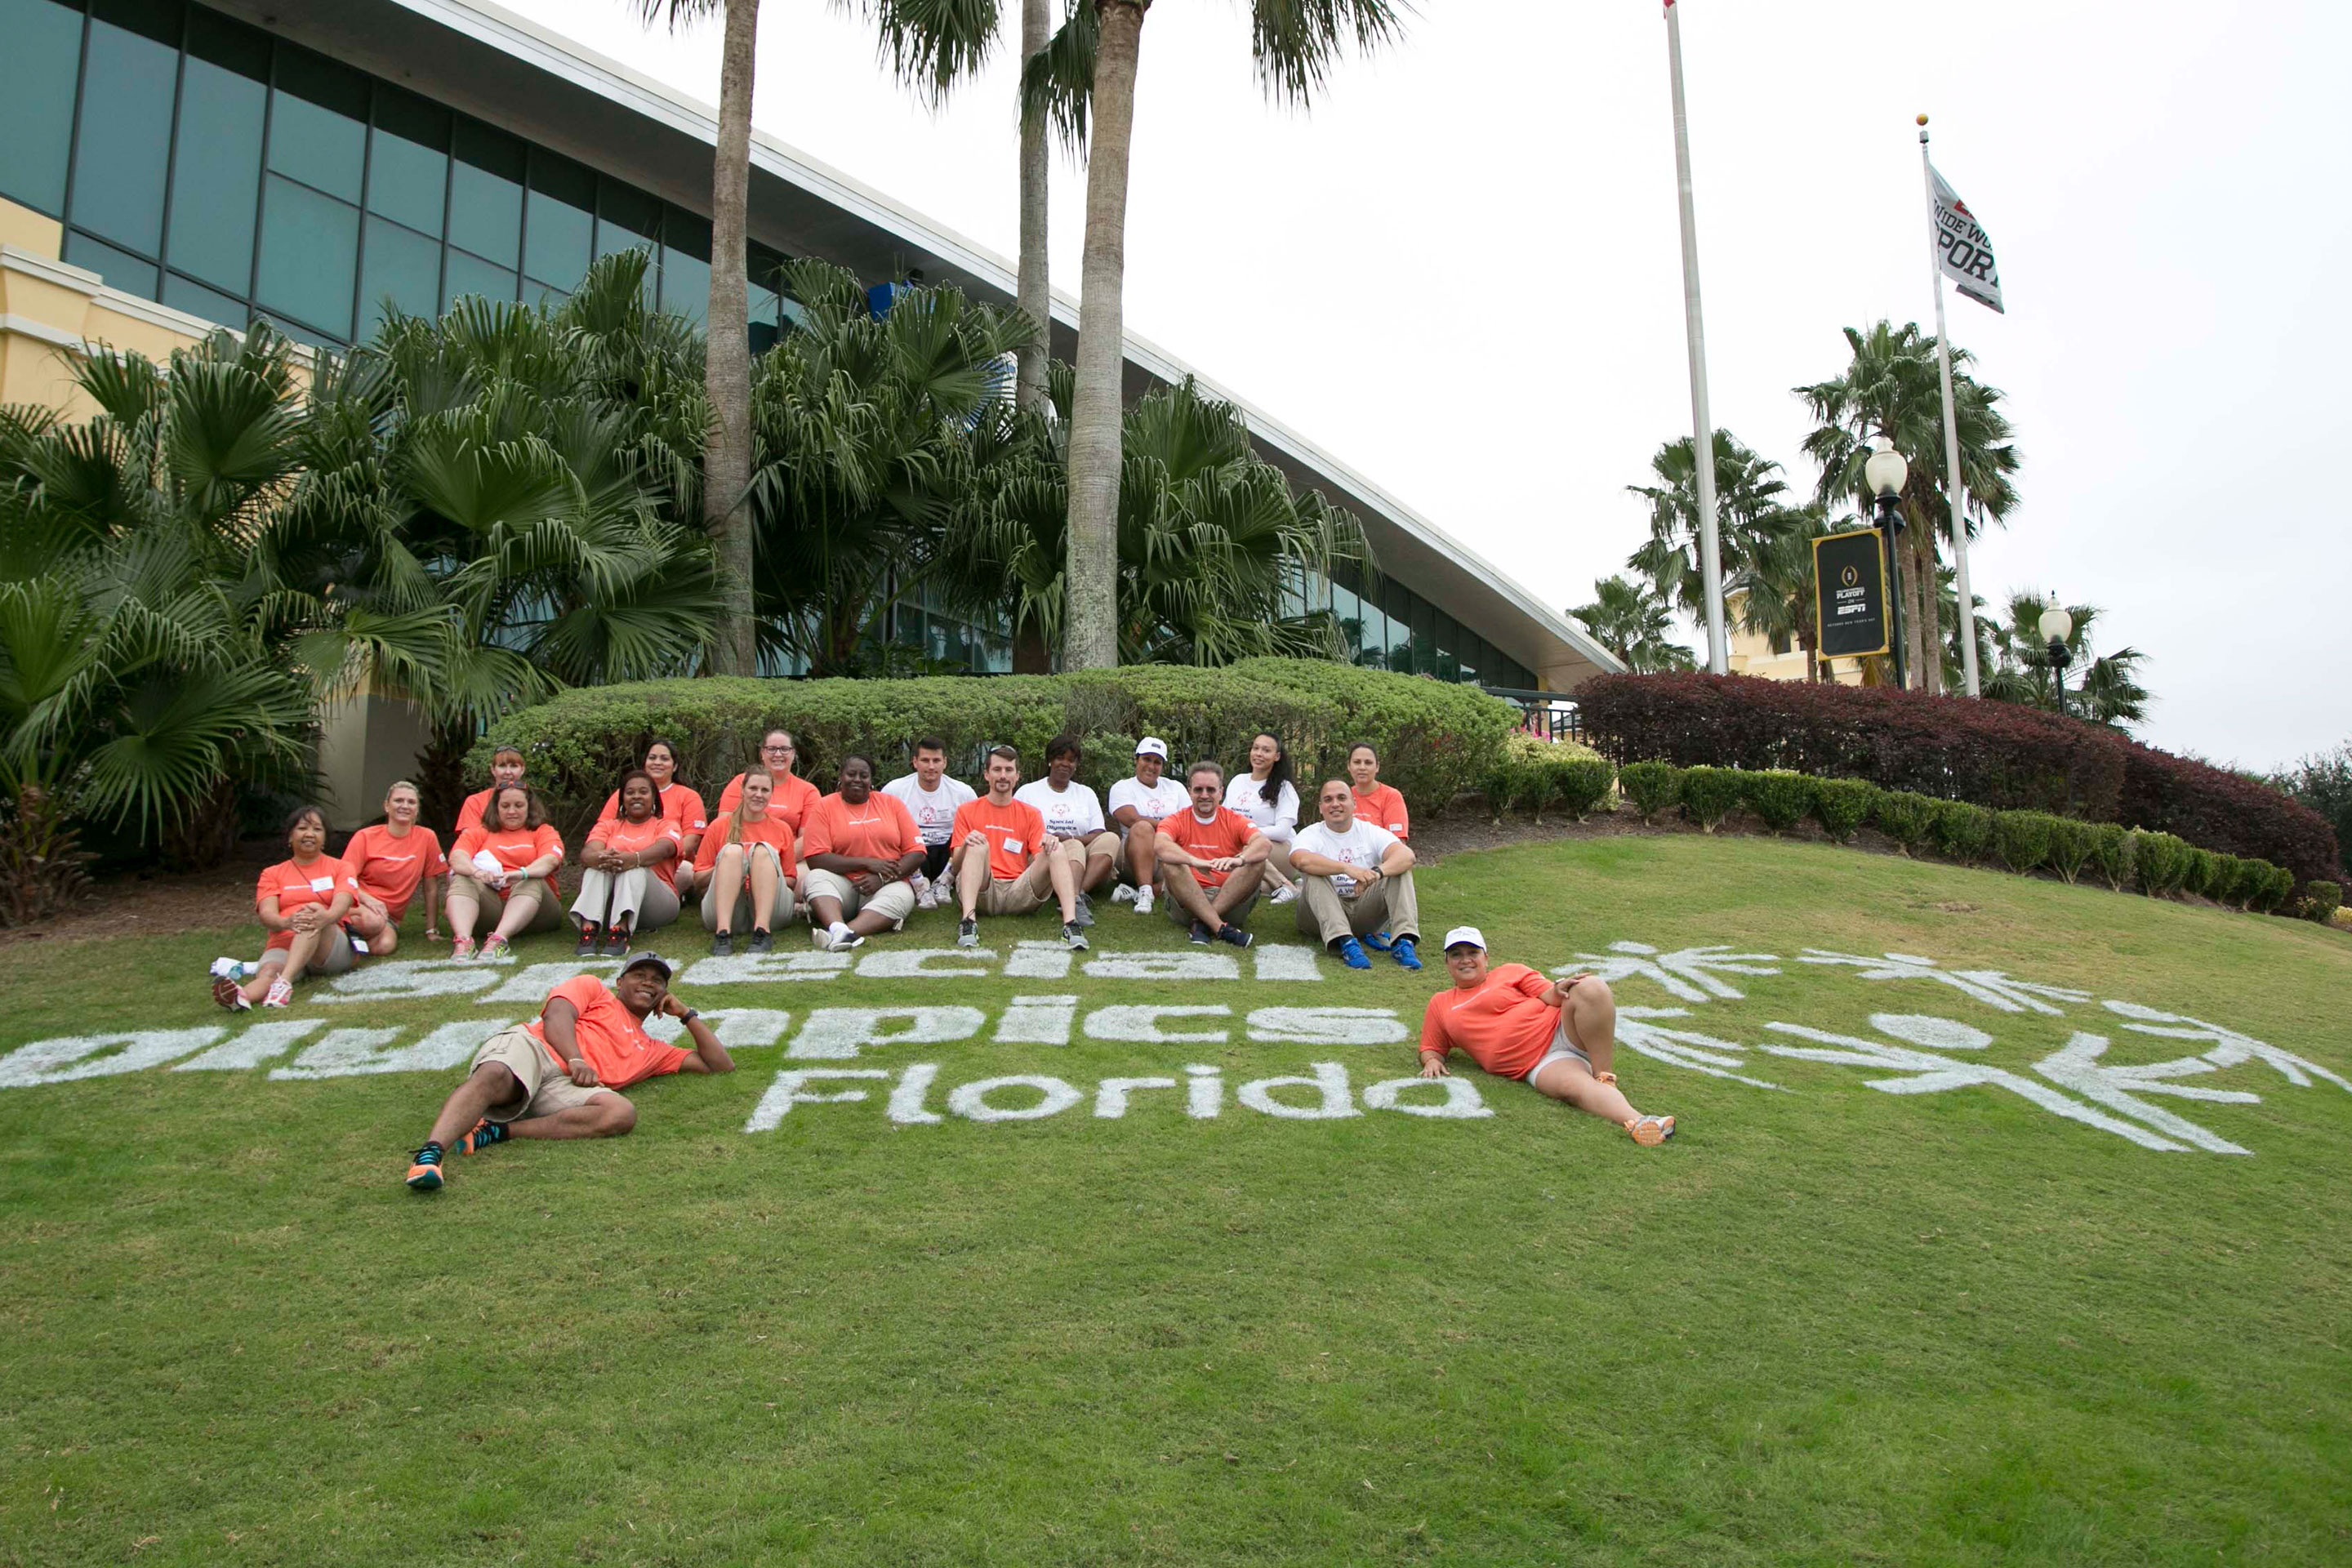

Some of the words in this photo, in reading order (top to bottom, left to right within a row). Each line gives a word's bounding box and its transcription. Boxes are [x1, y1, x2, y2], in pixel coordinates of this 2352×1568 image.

[1935, 220, 1998, 287] POR
[1837, 589, 1865, 599] PLAYOFF
[1838, 604, 1866, 615] ESPN
[309, 940, 1324, 1004] Special
[744, 1062, 1494, 1134] Florida
